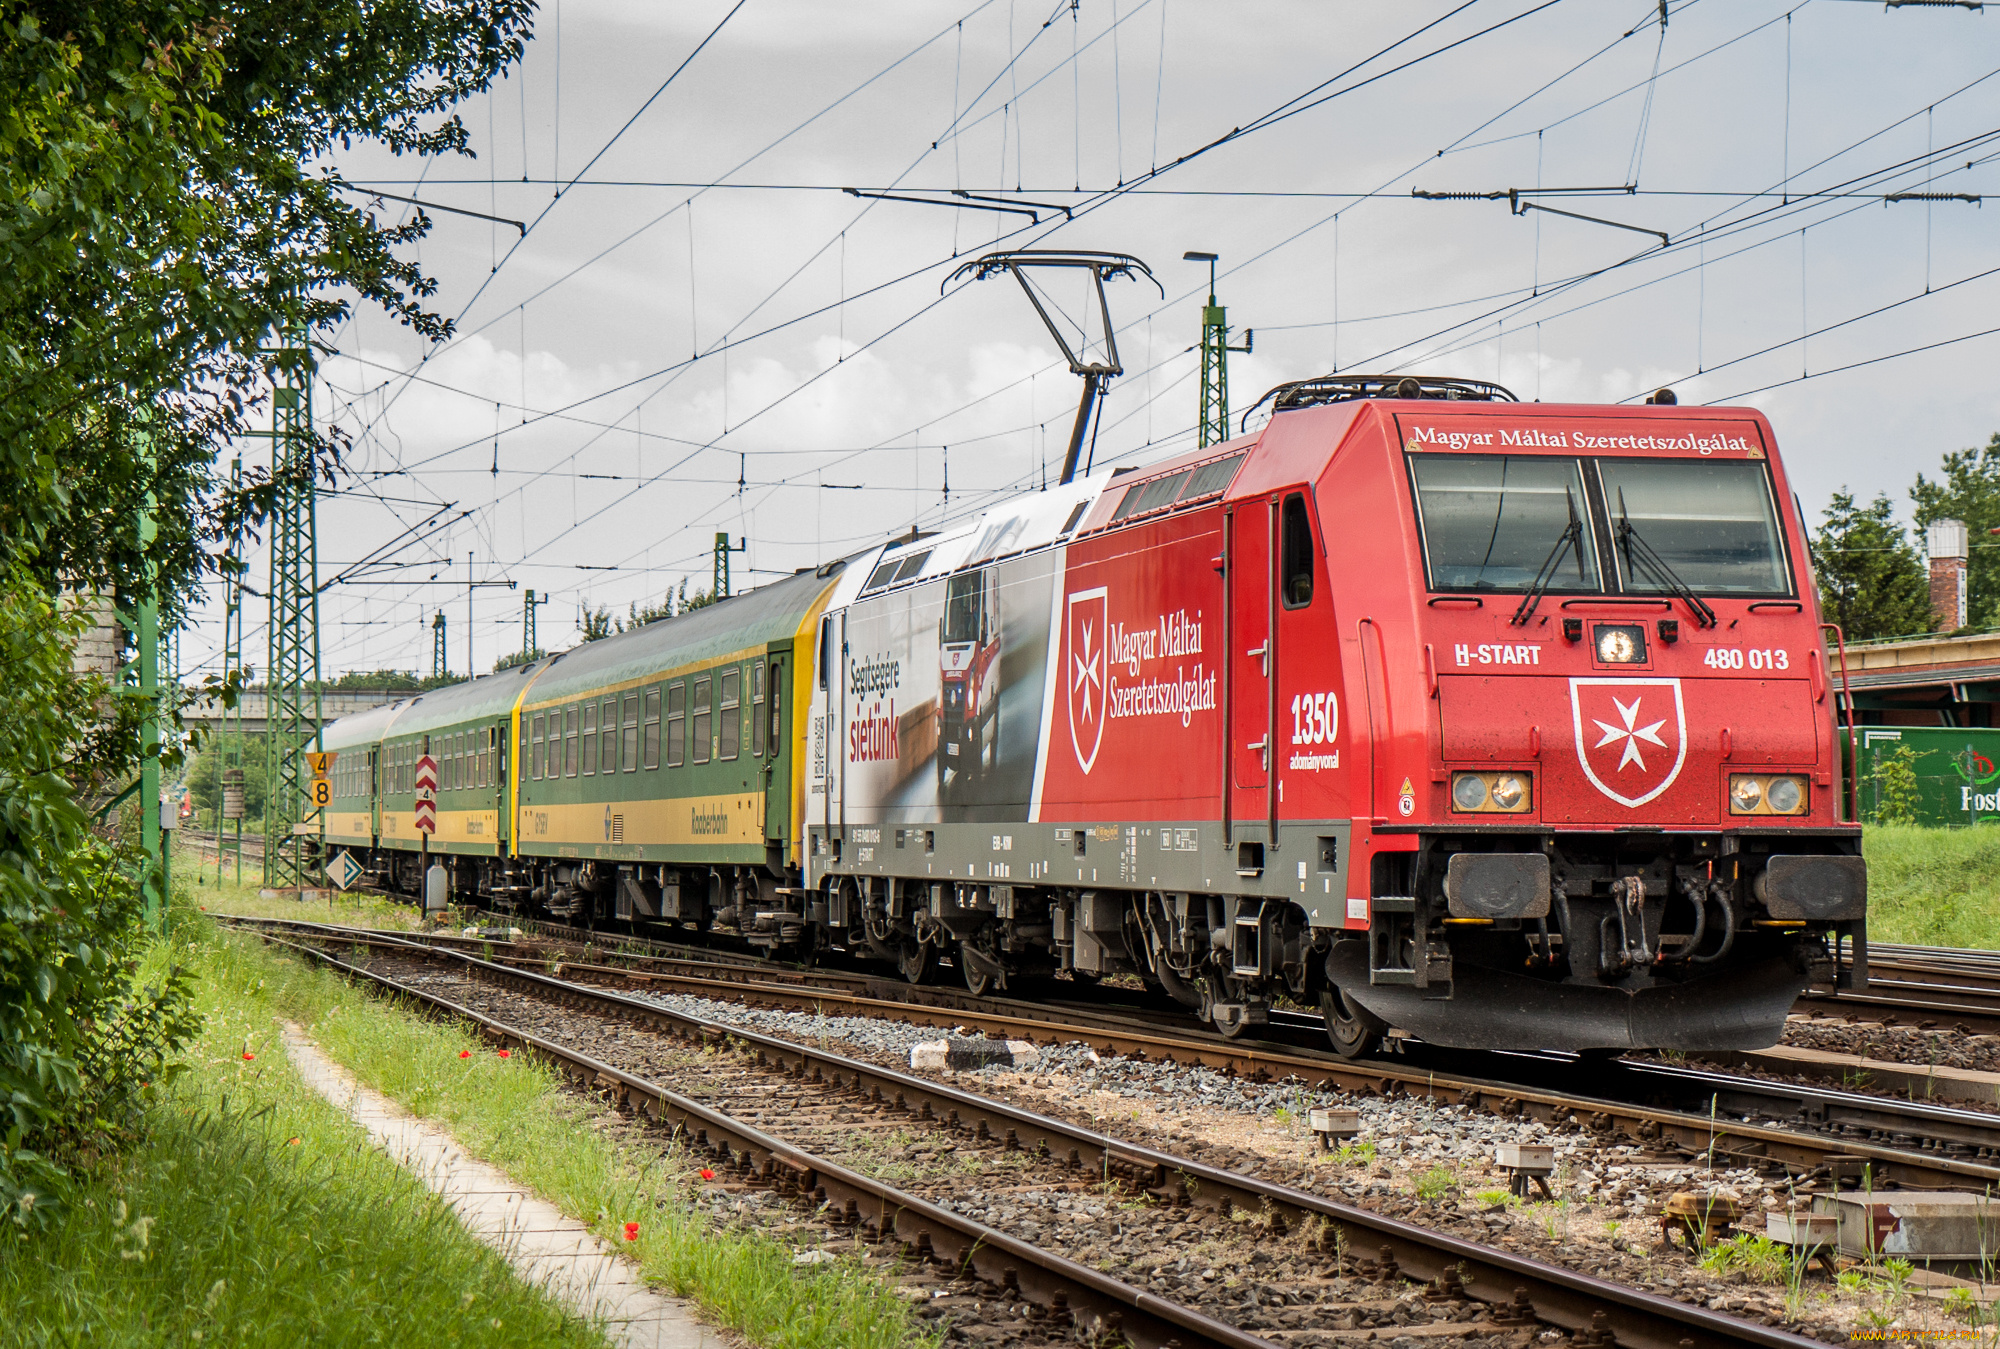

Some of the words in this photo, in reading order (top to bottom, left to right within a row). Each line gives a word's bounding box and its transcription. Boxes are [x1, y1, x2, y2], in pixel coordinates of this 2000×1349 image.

[1413, 426, 1494, 450] Magyar
[1499, 428, 1569, 448] Máltai
[1573, 431, 1750, 455] Szeretetszolgálat
[1110, 622, 1157, 677] Magyar
[1159, 608, 1203, 658] Máltai
[1454, 643, 1542, 667] H-START
[1703, 648, 1744, 670] 480
[1748, 648, 1790, 670] 013
[850, 651, 900, 702] Segítségére
[1110, 663, 1217, 728] Szeretetszolgálat
[850, 698, 900, 763] sietünk
[1290, 691, 1339, 745] 1350
[318, 753, 327, 775] 4
[1289, 749, 1340, 773] adományvonal
[316, 782, 330, 804] 8
[423, 789, 430, 800] 4
